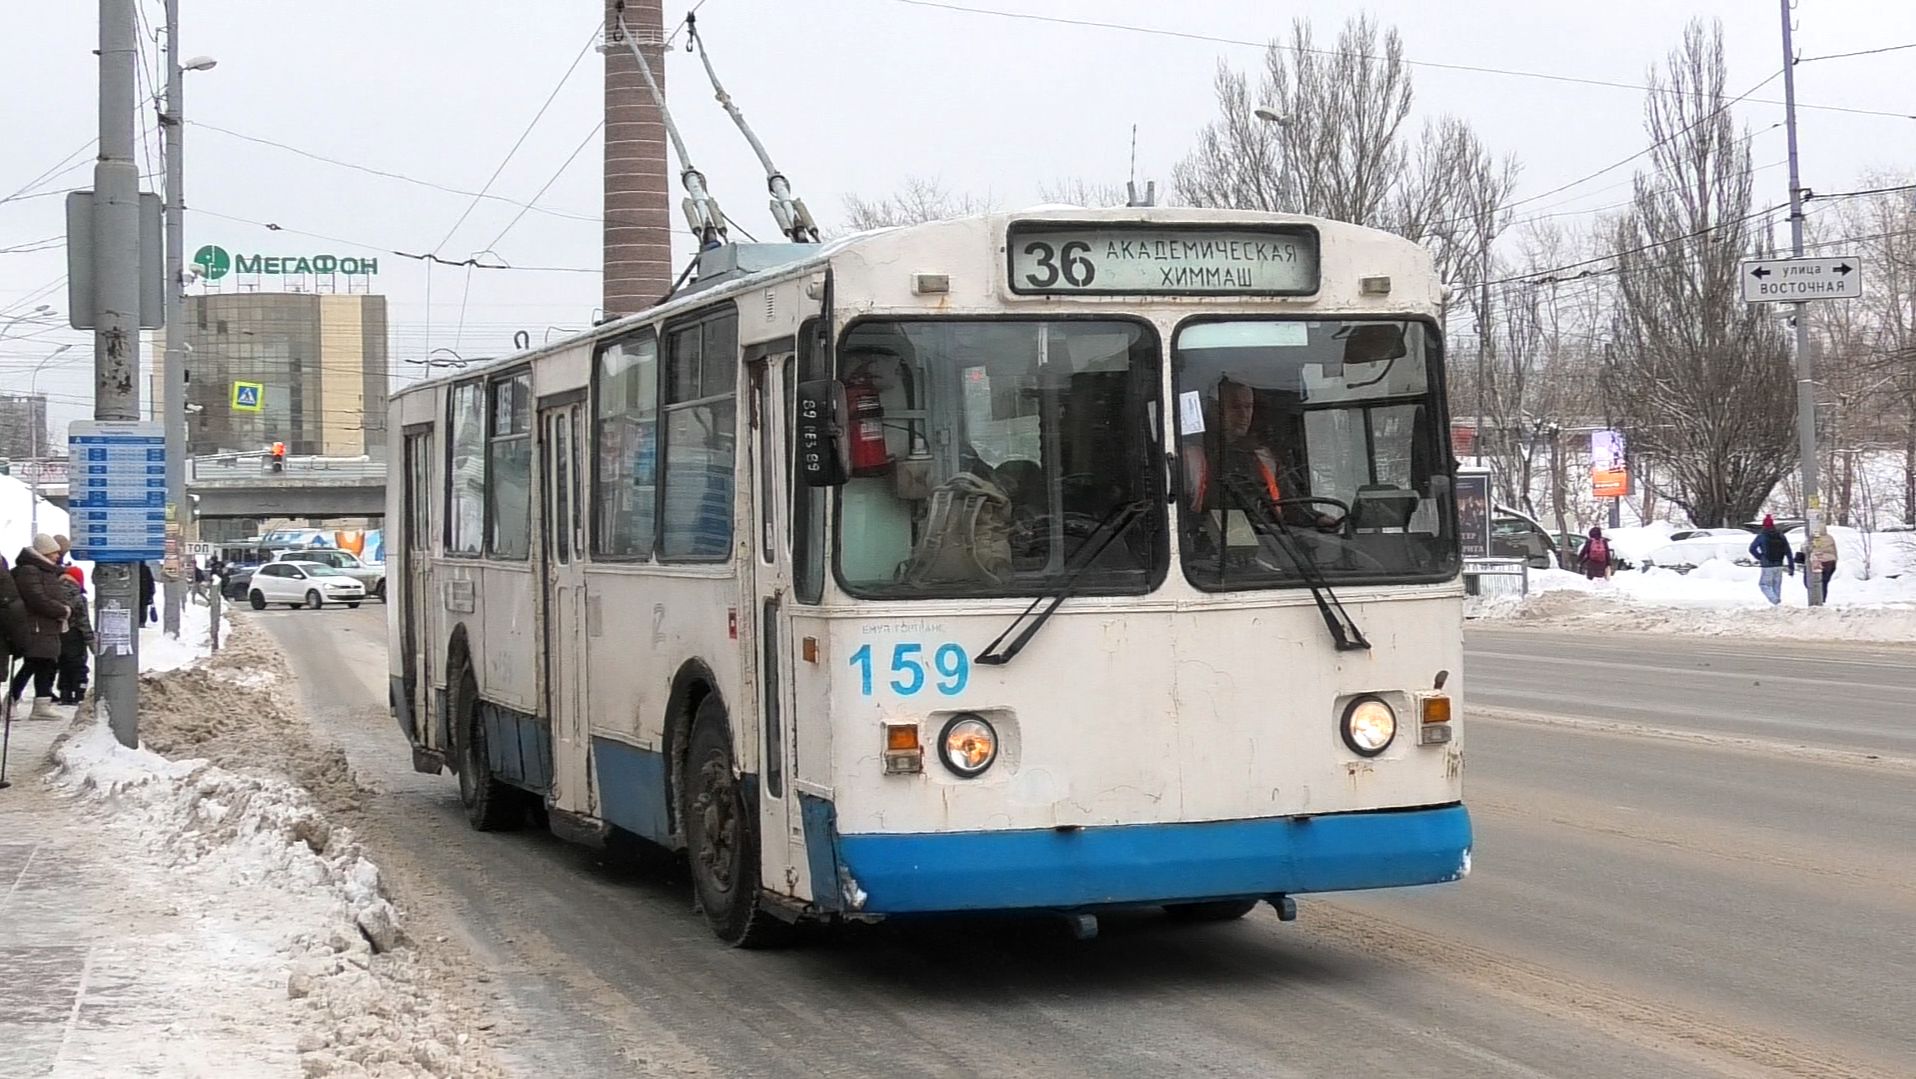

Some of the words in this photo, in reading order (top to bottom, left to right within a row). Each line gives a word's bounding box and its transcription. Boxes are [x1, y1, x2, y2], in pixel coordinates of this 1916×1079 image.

[235, 254, 378, 275] МЕГАФОН
[1024, 241, 1096, 288] 36
[1106, 240, 1297, 263] АКАДЕМИЧЕСКАЯ
[1782, 265, 1822, 278] улица
[1160, 267, 1253, 287] ХИММАШ
[1760, 280, 1845, 295] ВОСТОЧНАЯ
[187, 543, 209, 553] ТОП
[849, 642, 969, 696] 159
